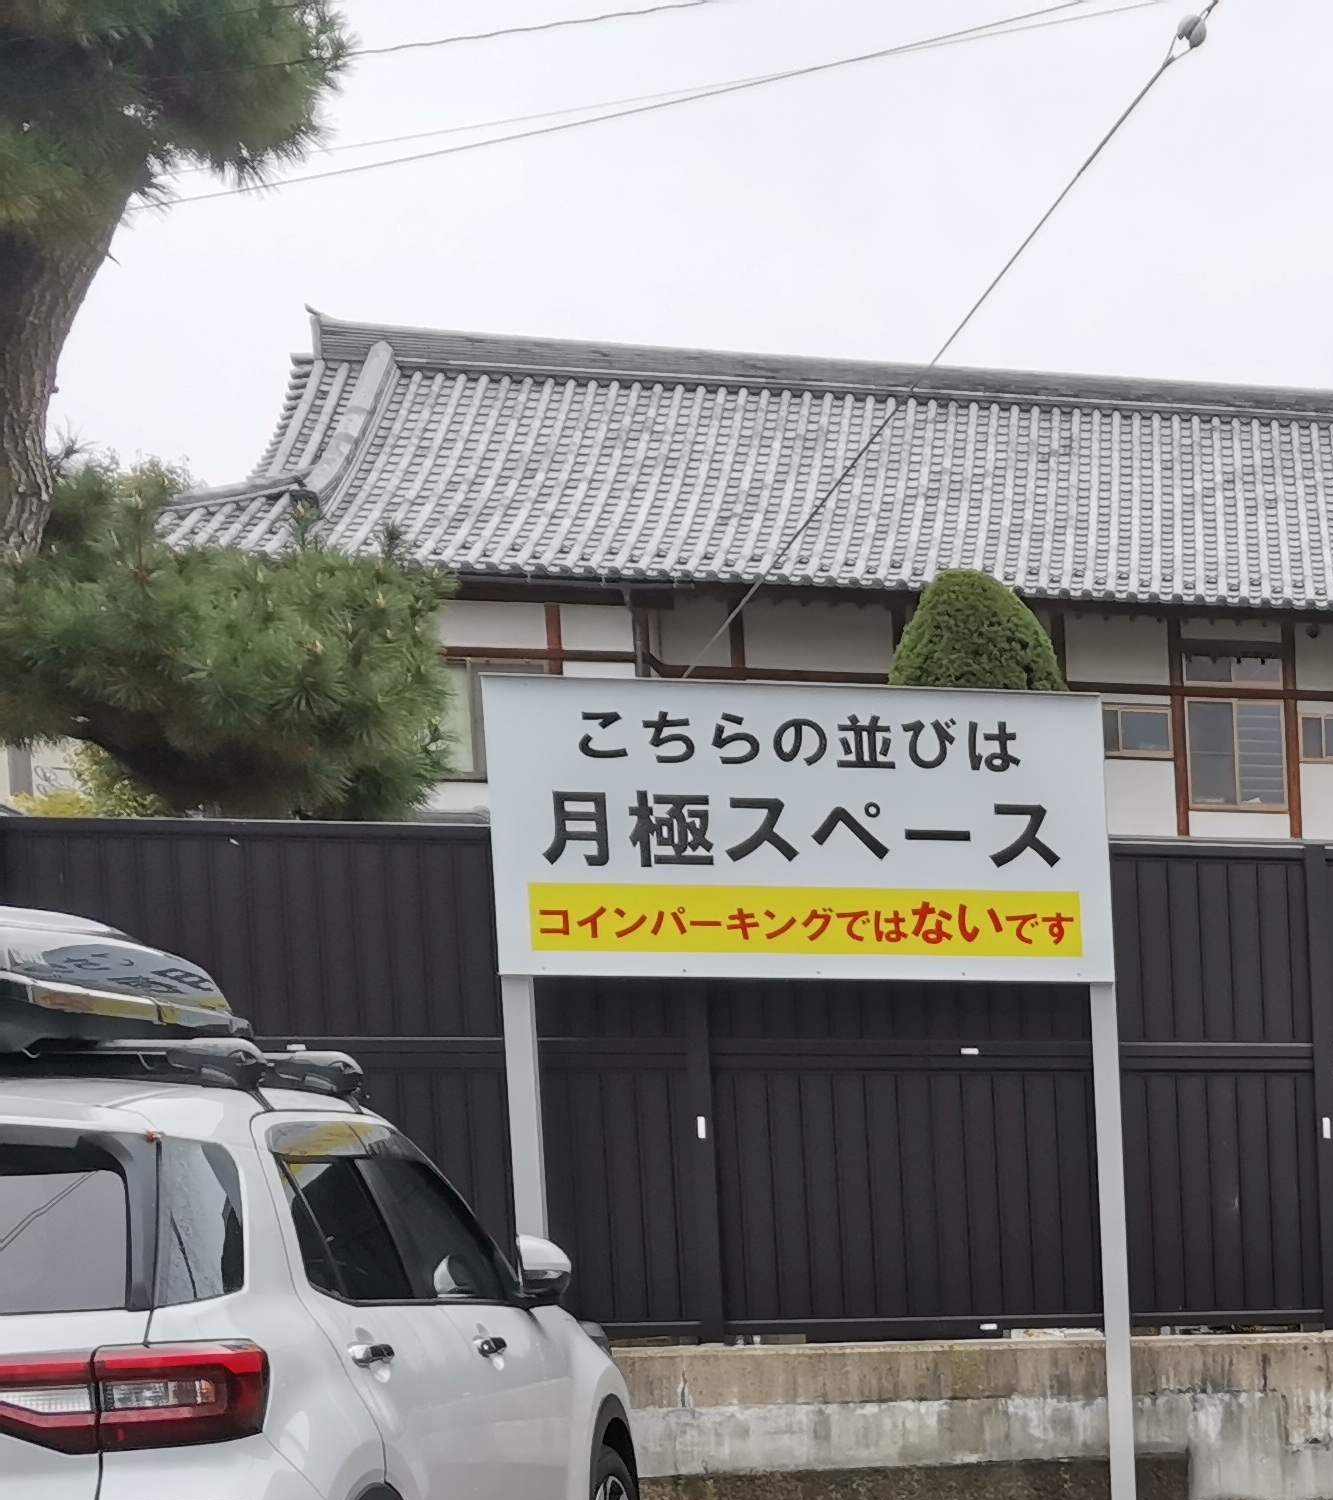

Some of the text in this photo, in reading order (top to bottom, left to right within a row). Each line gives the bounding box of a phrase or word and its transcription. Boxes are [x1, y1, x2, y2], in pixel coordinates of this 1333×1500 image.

[577, 709, 1022, 772] こちらの並びは
[542, 789, 1062, 868] 月極スペース
[538, 900, 1076, 946] コインパーキングではないです
